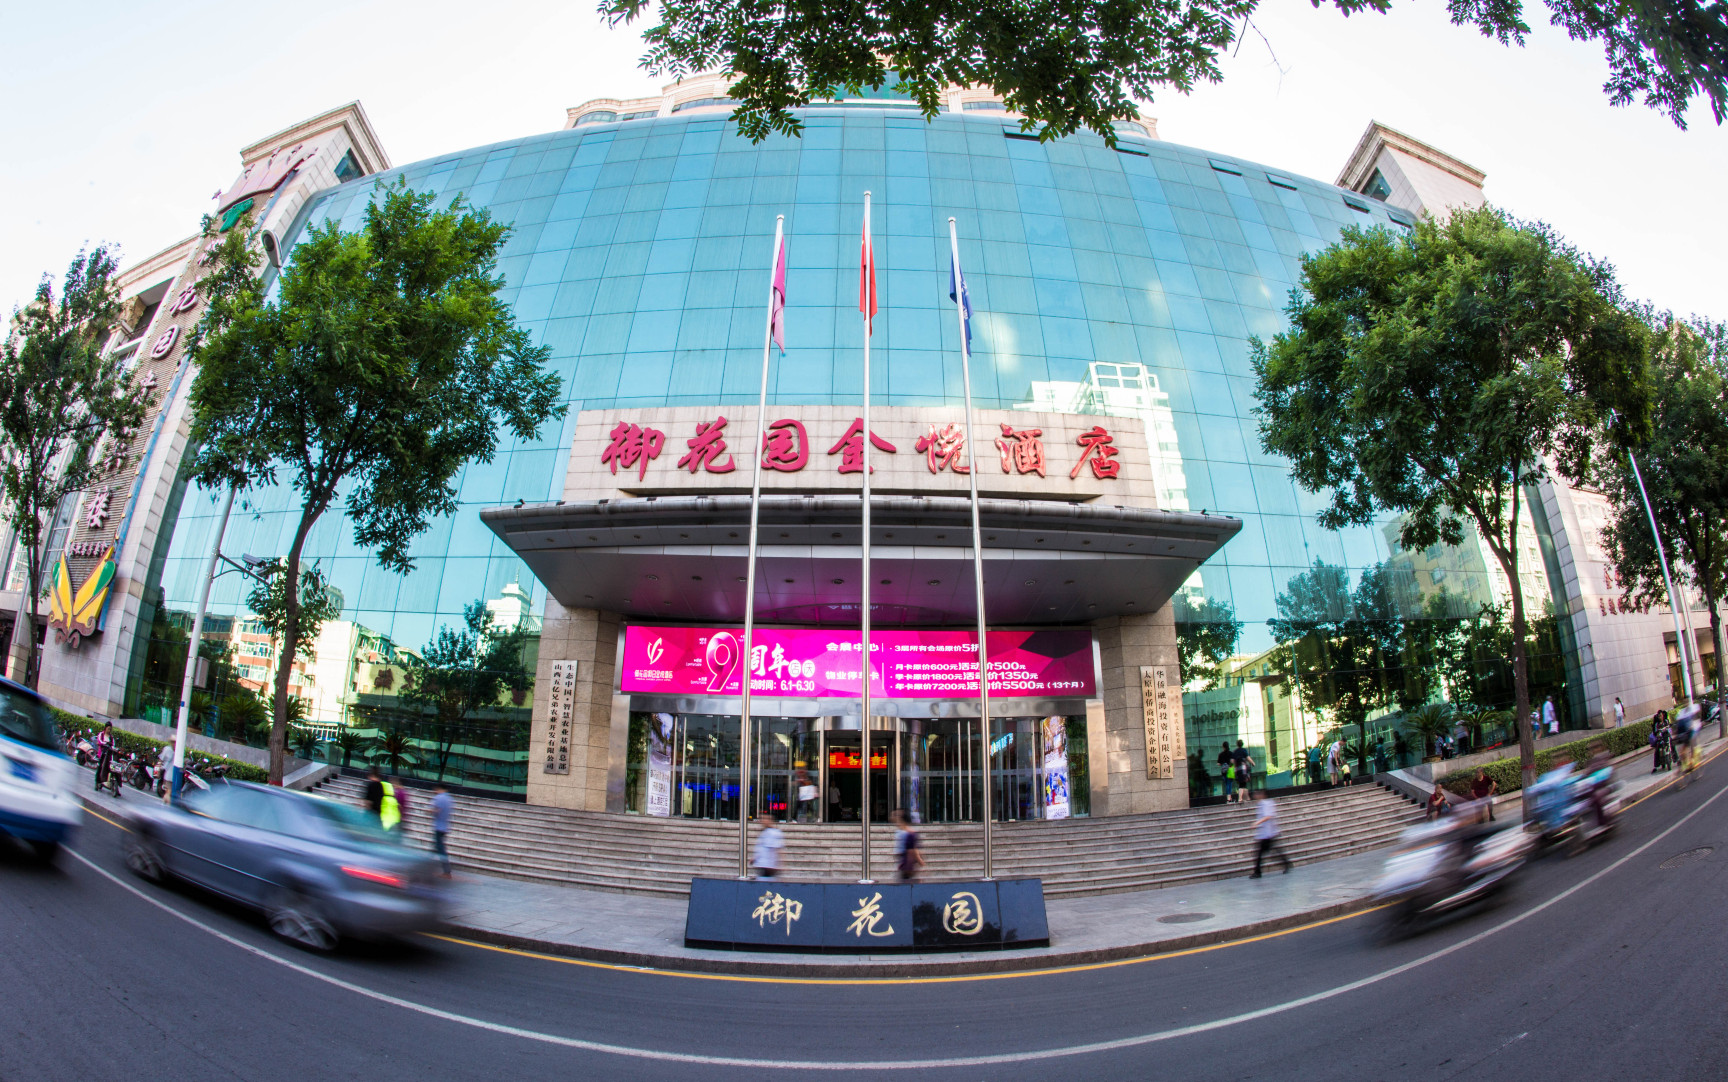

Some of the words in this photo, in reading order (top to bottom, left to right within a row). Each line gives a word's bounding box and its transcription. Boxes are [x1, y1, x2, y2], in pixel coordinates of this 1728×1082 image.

[601, 416, 1121, 482] 御花园金悦酒店
[706, 631, 739, 692] 9
[750, 642, 790, 679] 周年
[825, 642, 880, 652] 会展中心
[546, 663, 562, 770] 山西五亿兄弟农业开发有限公司
[750, 678, 815, 692] 动时间：6.1-6.30
[1144, 670, 1158, 775] 太原市侨商投资企业协会
[1156, 670, 1171, 774] 华侨融海投资有限公司
[751, 890, 984, 937] 御花园
